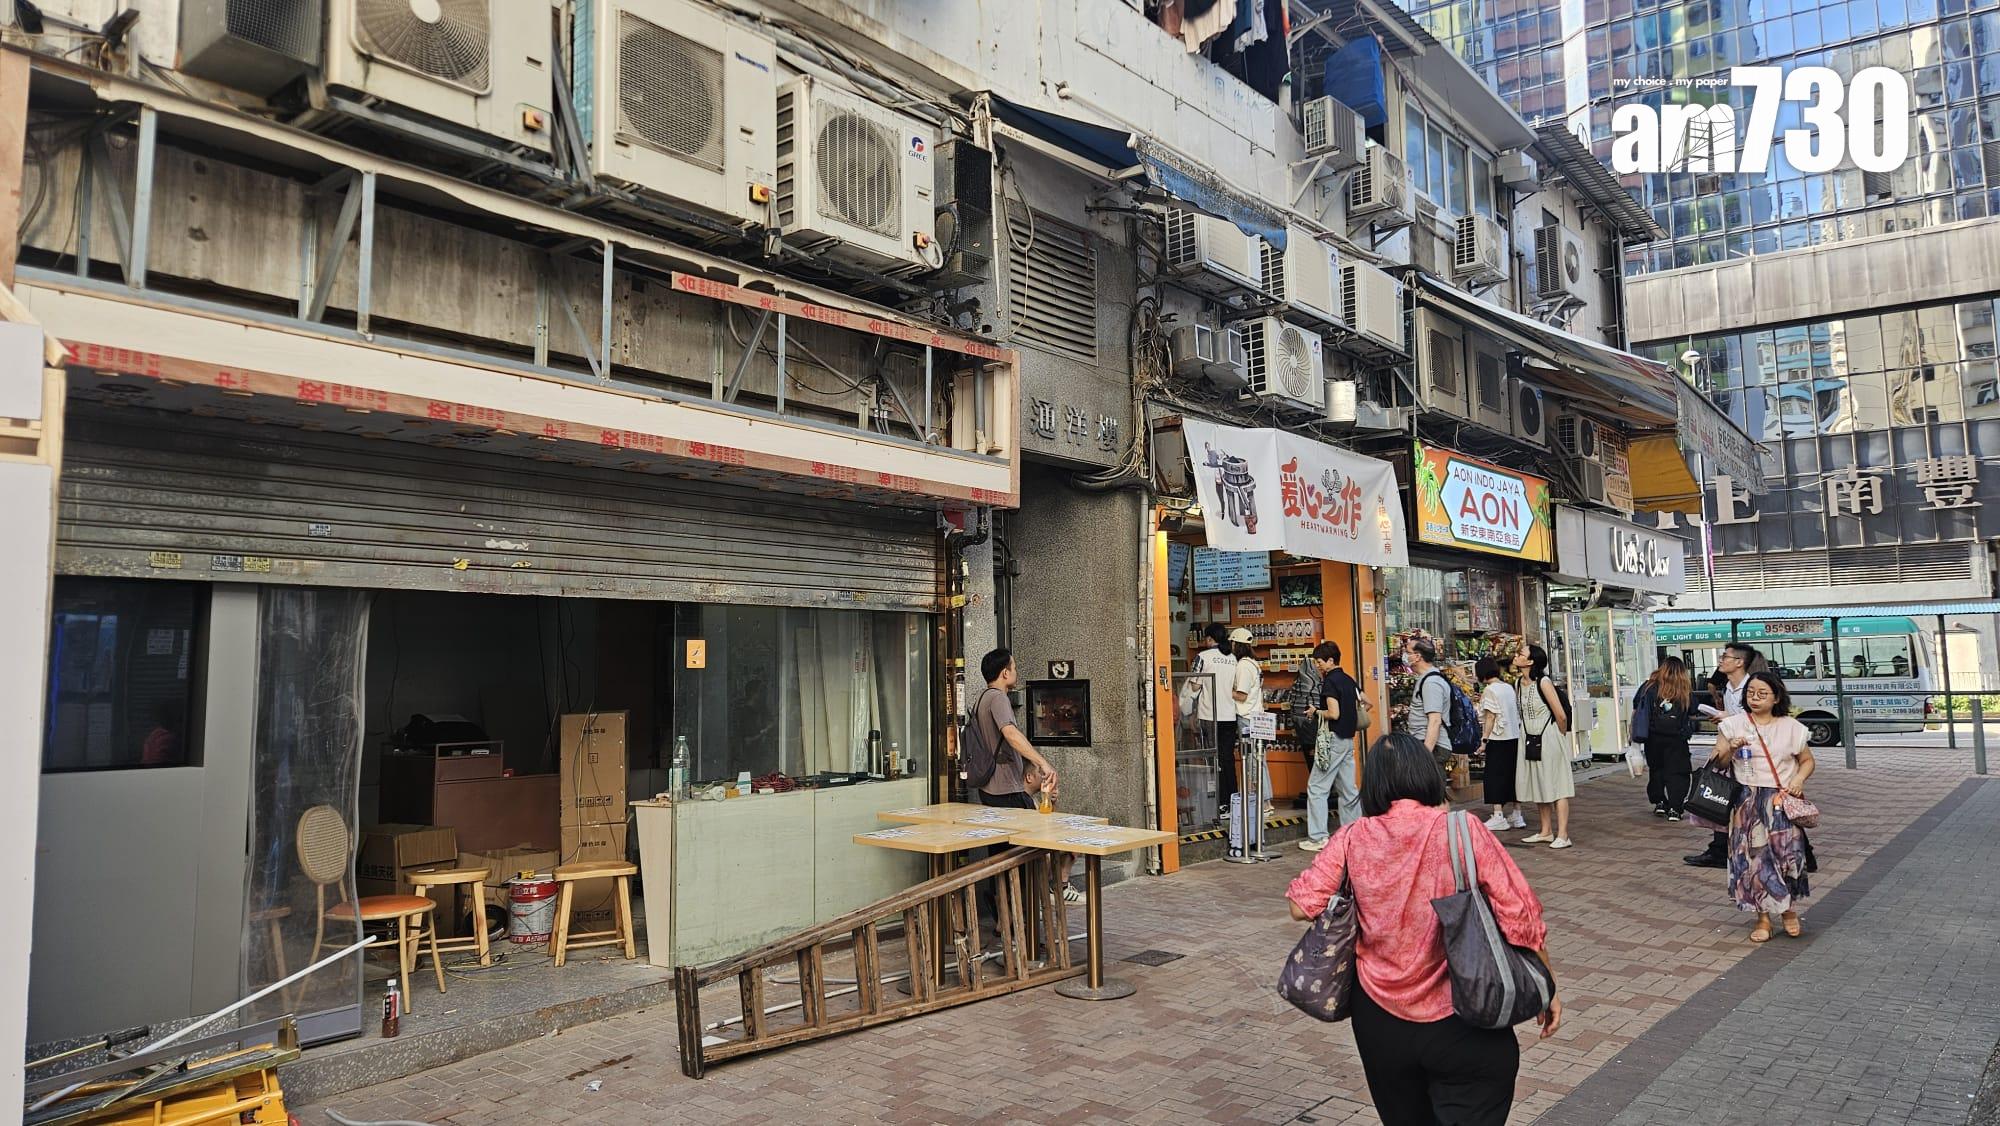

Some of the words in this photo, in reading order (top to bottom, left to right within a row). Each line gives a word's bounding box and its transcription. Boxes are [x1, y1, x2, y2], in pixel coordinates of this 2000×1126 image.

[1454, 467, 1473, 484] AON
[1475, 473, 1495, 490] INDO
[1496, 479, 1520, 497] JAYA
[1459, 487, 1519, 531] AON
[1301, 520, 1348, 538] HEARTWARMING
[1460, 523, 1520, 547] 新安東南亞食品
